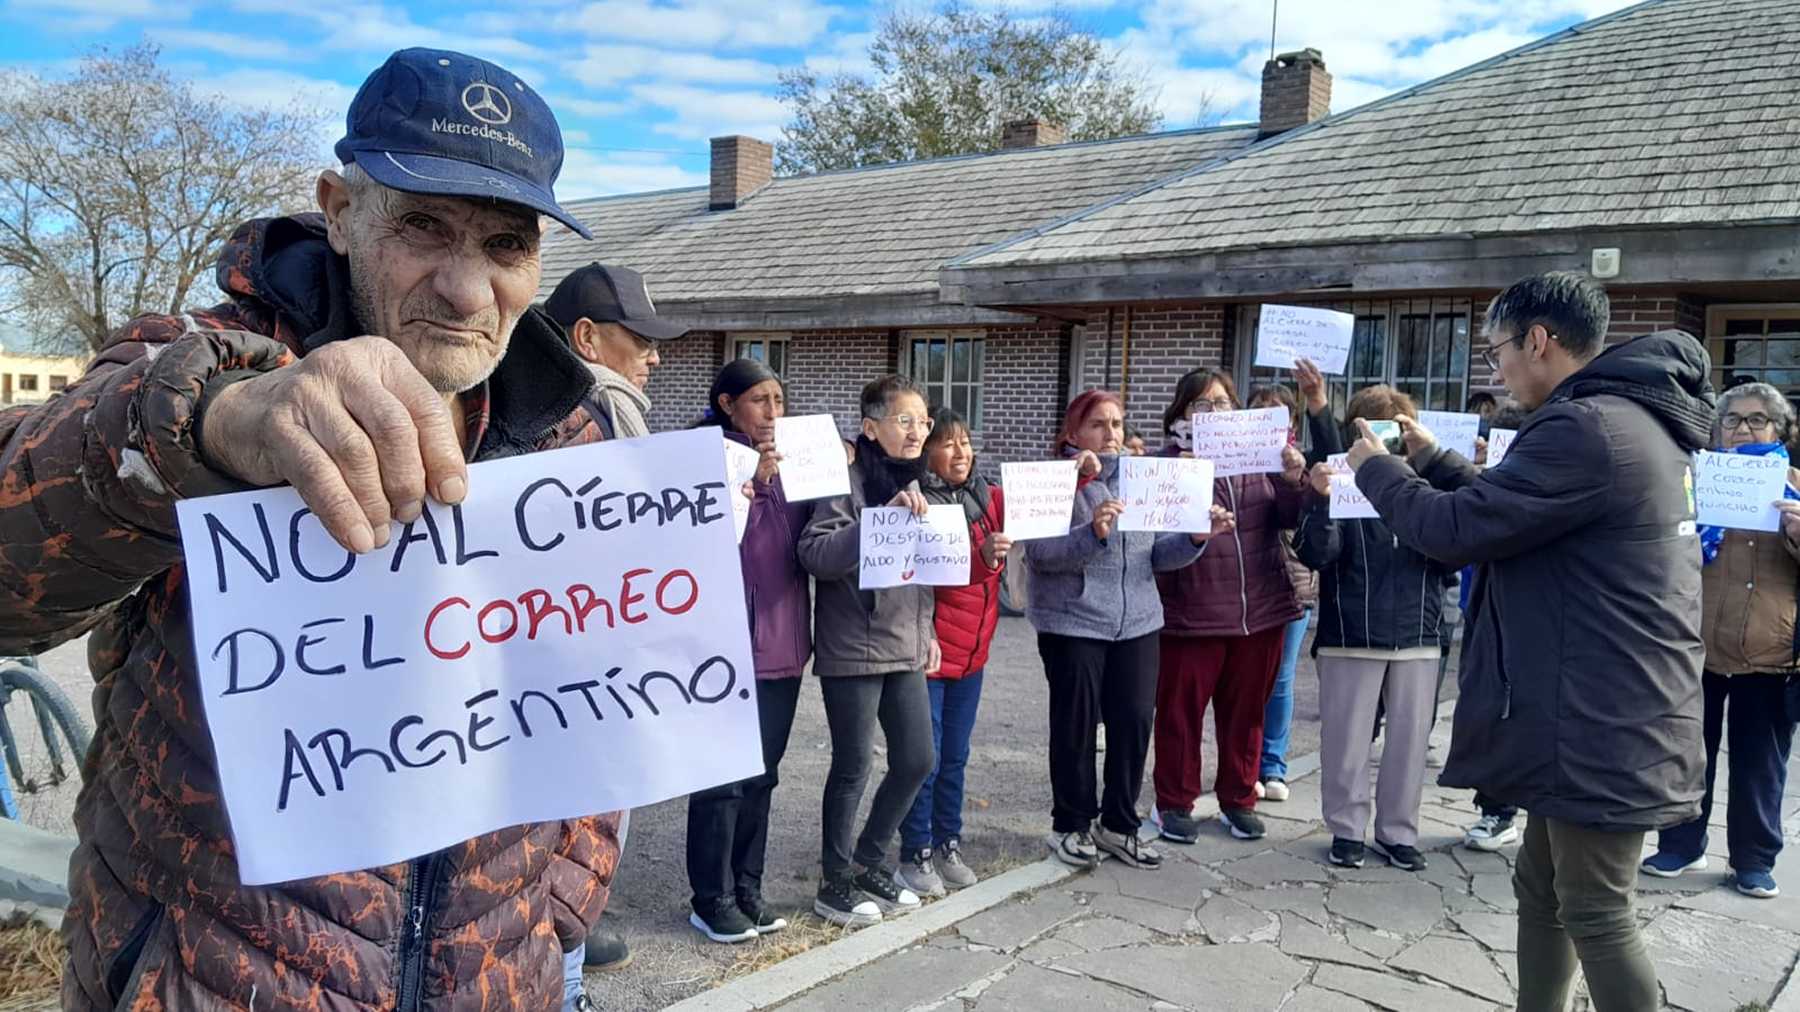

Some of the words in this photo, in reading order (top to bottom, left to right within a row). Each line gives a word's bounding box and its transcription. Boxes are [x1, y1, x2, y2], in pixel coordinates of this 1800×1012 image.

[432, 118, 533, 158] Mercedes-Benz
[872, 511, 899, 527] NO
[905, 510, 930, 525] AL
[203, 503, 357, 593] NO
[390, 498, 499, 573] AL
[863, 555, 895, 570] ALDO
[913, 553, 969, 566] GUSTAVO
[212, 615, 406, 697] DEL
[424, 568, 700, 660] CORREO
